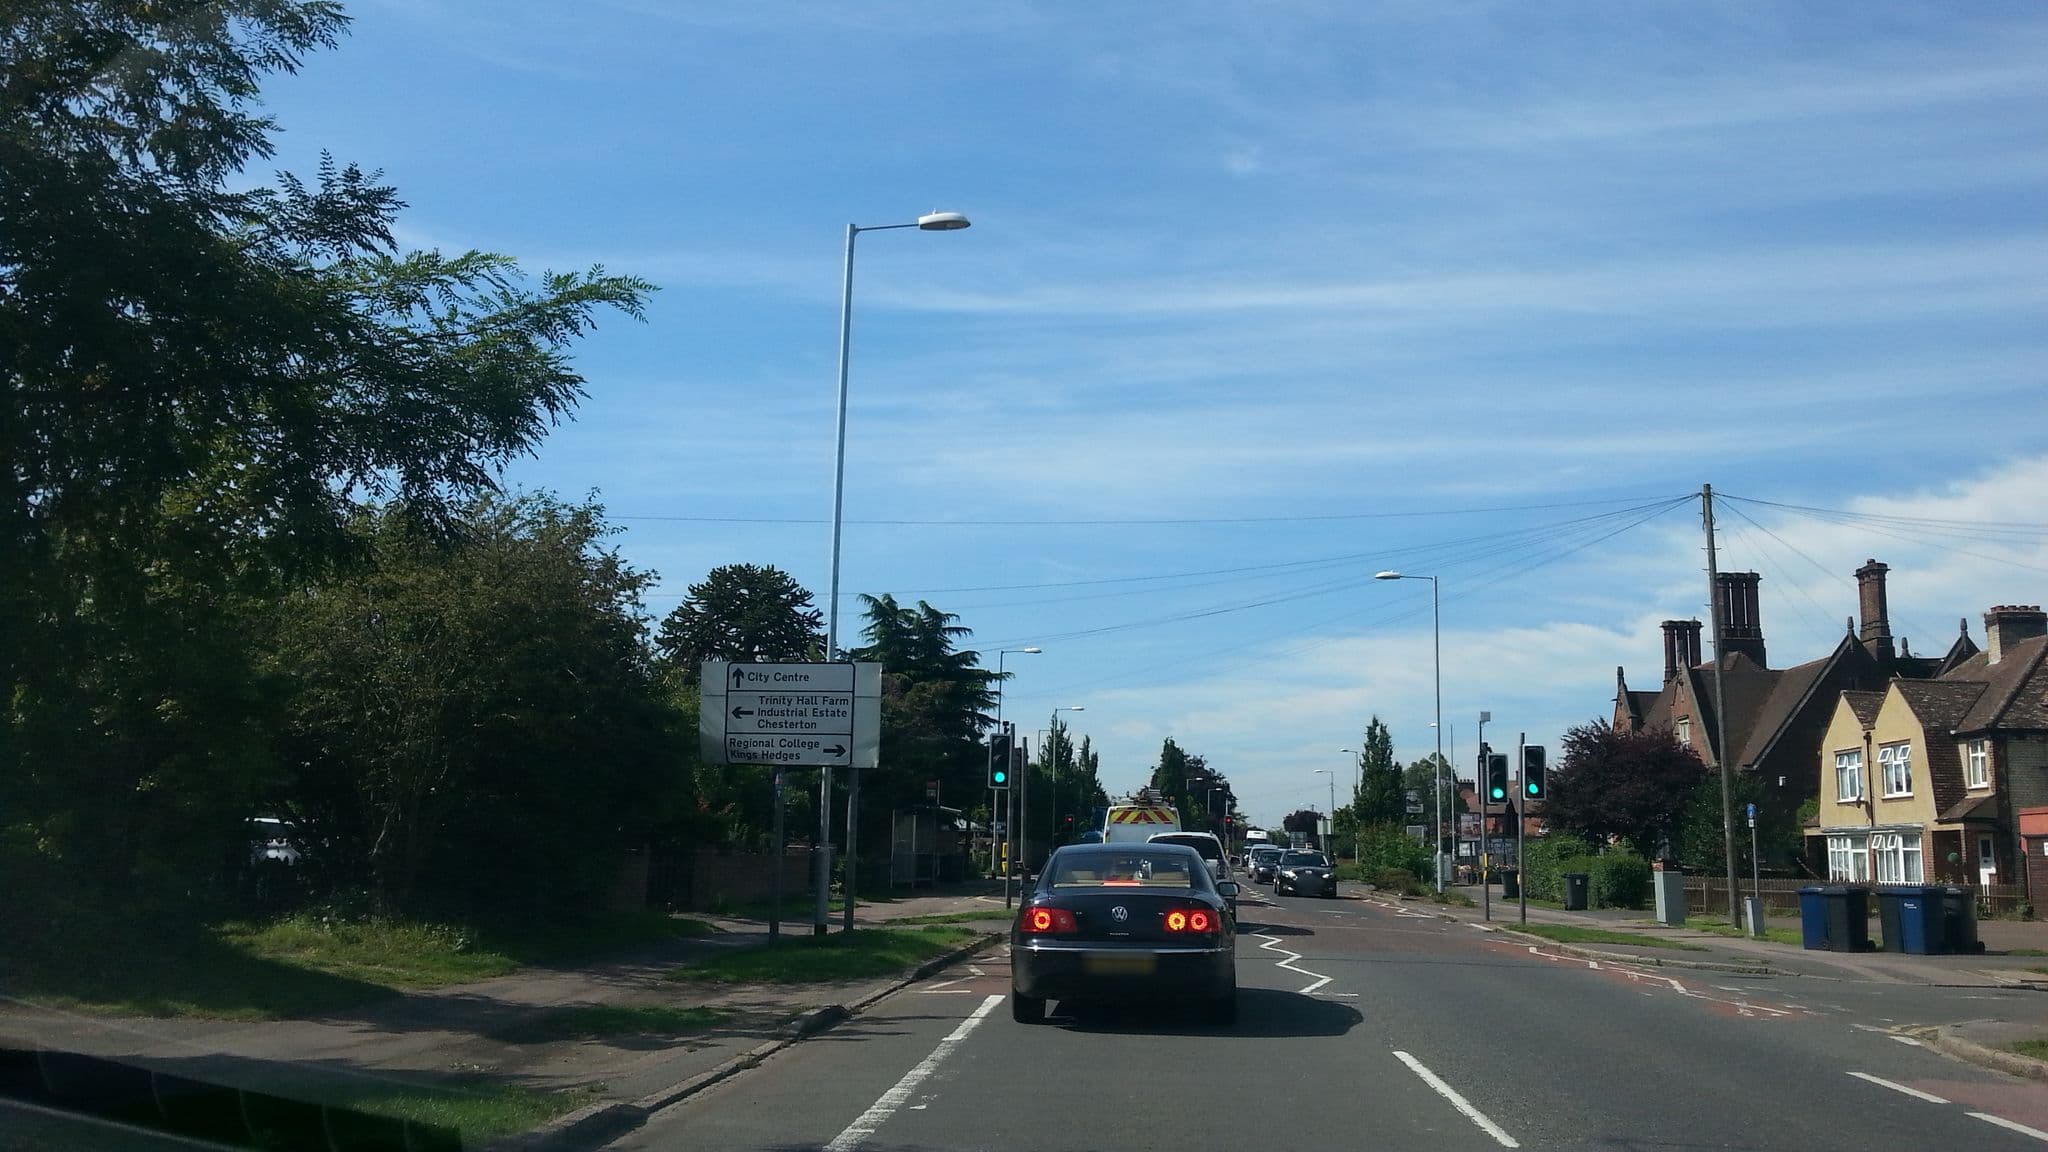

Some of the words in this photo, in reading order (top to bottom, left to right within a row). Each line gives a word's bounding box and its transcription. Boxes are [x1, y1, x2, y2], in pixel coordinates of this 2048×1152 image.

[748, 672, 770, 682] City
[773, 672, 810, 682] Centre
[759, 696, 792, 706] Trinity
[796, 696, 818, 706] Hall
[822, 696, 849, 706] Farm
[757, 707, 808, 717] Industrial
[812, 708, 848, 717] Estate
[757, 719, 817, 729] Chesterton
[729, 738, 774, 749] Regional
[779, 739, 820, 749] College
[730, 750, 758, 760] Kings
[761, 751, 801, 760] Hedges
